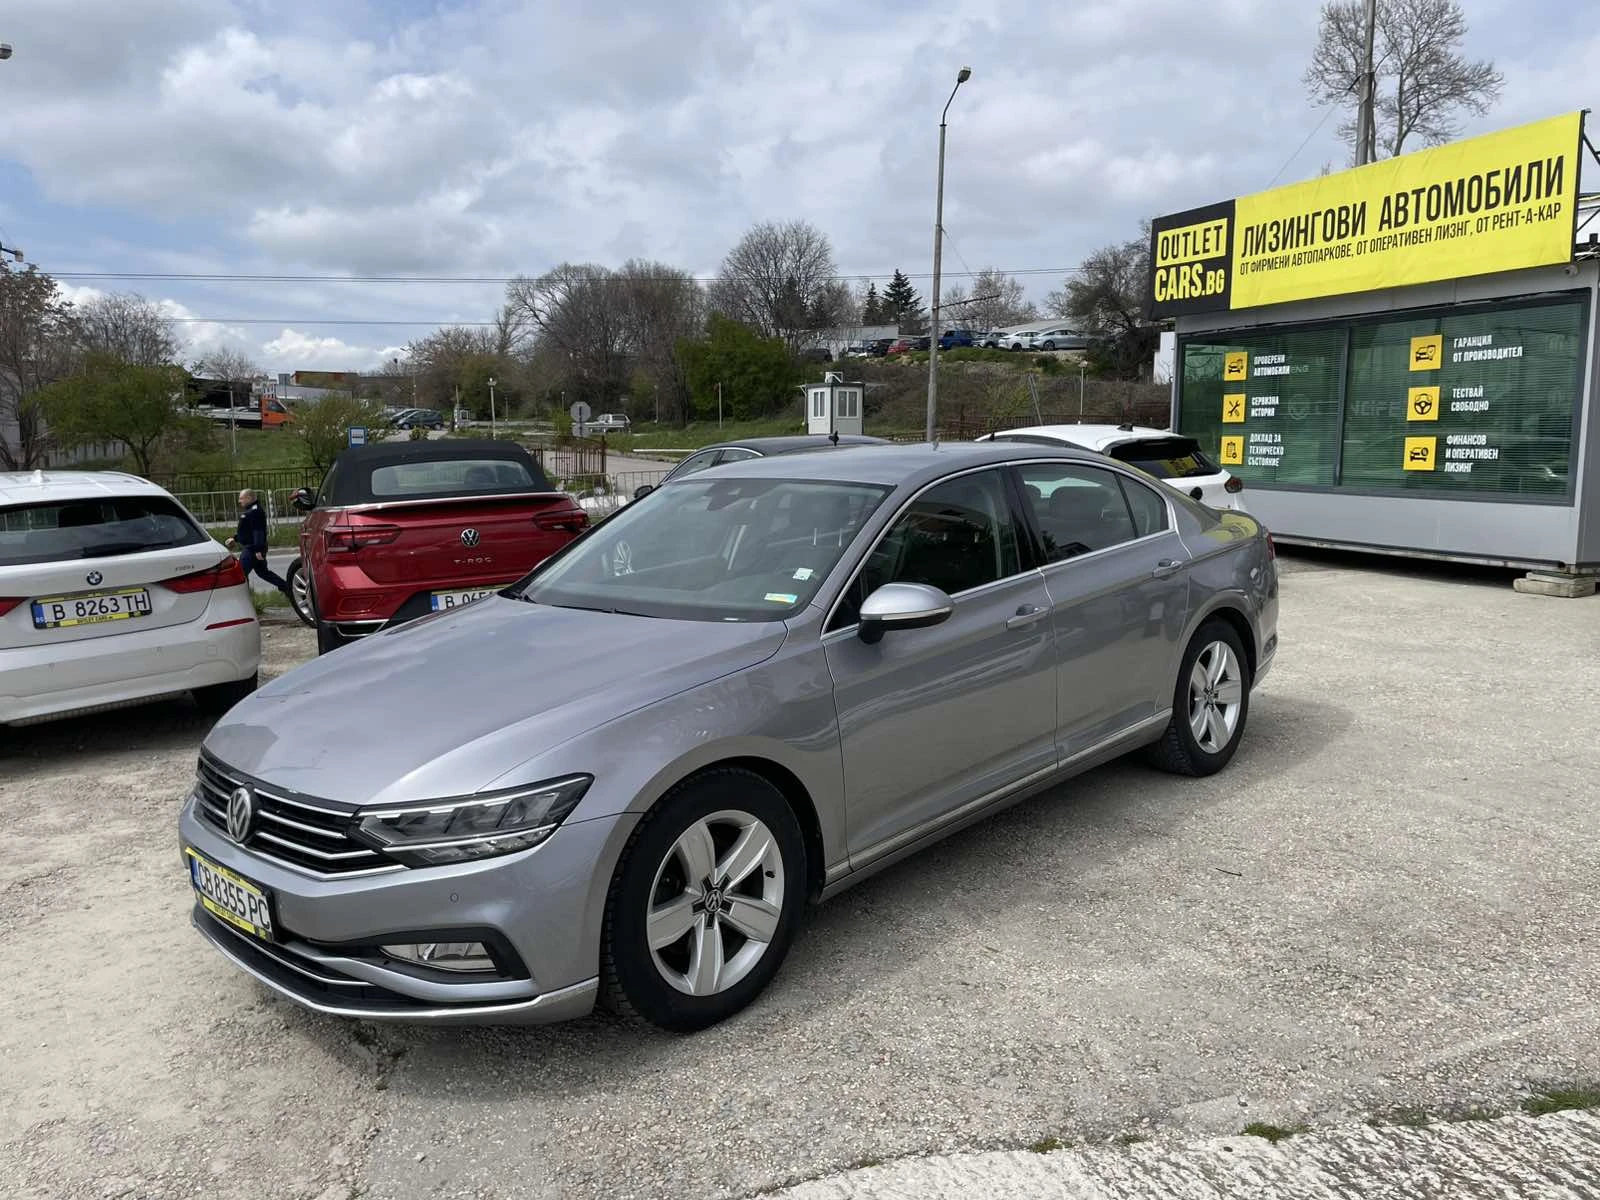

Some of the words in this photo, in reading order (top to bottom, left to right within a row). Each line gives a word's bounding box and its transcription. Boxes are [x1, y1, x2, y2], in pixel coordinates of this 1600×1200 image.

[1241, 201, 1367, 258] ЛИЗИНГОВИ
[1378, 155, 1564, 232] АВТОМОБИЛИ
[1161, 225, 1223, 261] OUTLET
[1240, 262, 1249, 275] ОТ
[1250, 254, 1290, 272] ФИРМЕНИ
[1291, 243, 1354, 268] АВТОПАРКОВЕ,
[1356, 239, 1369, 255] ОТ
[1370, 227, 1432, 253] ОПЕРАТИВЕН
[1434, 220, 1473, 241] ЛИЗНГ,
[1476, 216, 1490, 234] ОТ
[1492, 202, 1561, 231] РЕНТ-А-КАР
[1154, 263, 1225, 302] CARS.BG
[1453, 335, 1493, 348] ГАРАНЦИЯ
[1253, 355, 1285, 365] ПРОВЕРЕНИ
[1453, 352, 1462, 362] ОТ
[1464, 346, 1523, 362] ПРОИЗВОДИТЕЛ
[1253, 365, 1290, 376] АВТОМОБИЛИ
[1453, 385, 1483, 398] ТЕСТВАЙ
[1251, 396, 1279, 406] СЕРВИЗНА
[1451, 401, 1489, 412] СВОБОДНО
[1250, 433, 1272, 444] ДОКЛАД
[1446, 435, 1487, 445] ФИНАНСОВ
[1445, 449, 1451, 459] И
[1452, 448, 1498, 459] ОПЕРАТИВЕН
[1444, 463, 1474, 473] ЛИЗИНГ
[52, 604, 66, 621] B
[75, 597, 120, 617] 8263
[122, 593, 148, 611] TH
[445, 595, 455, 608] B
[198, 862, 213, 896] CB
[214, 873, 246, 917] 8355
[247, 891, 270, 930] PC
